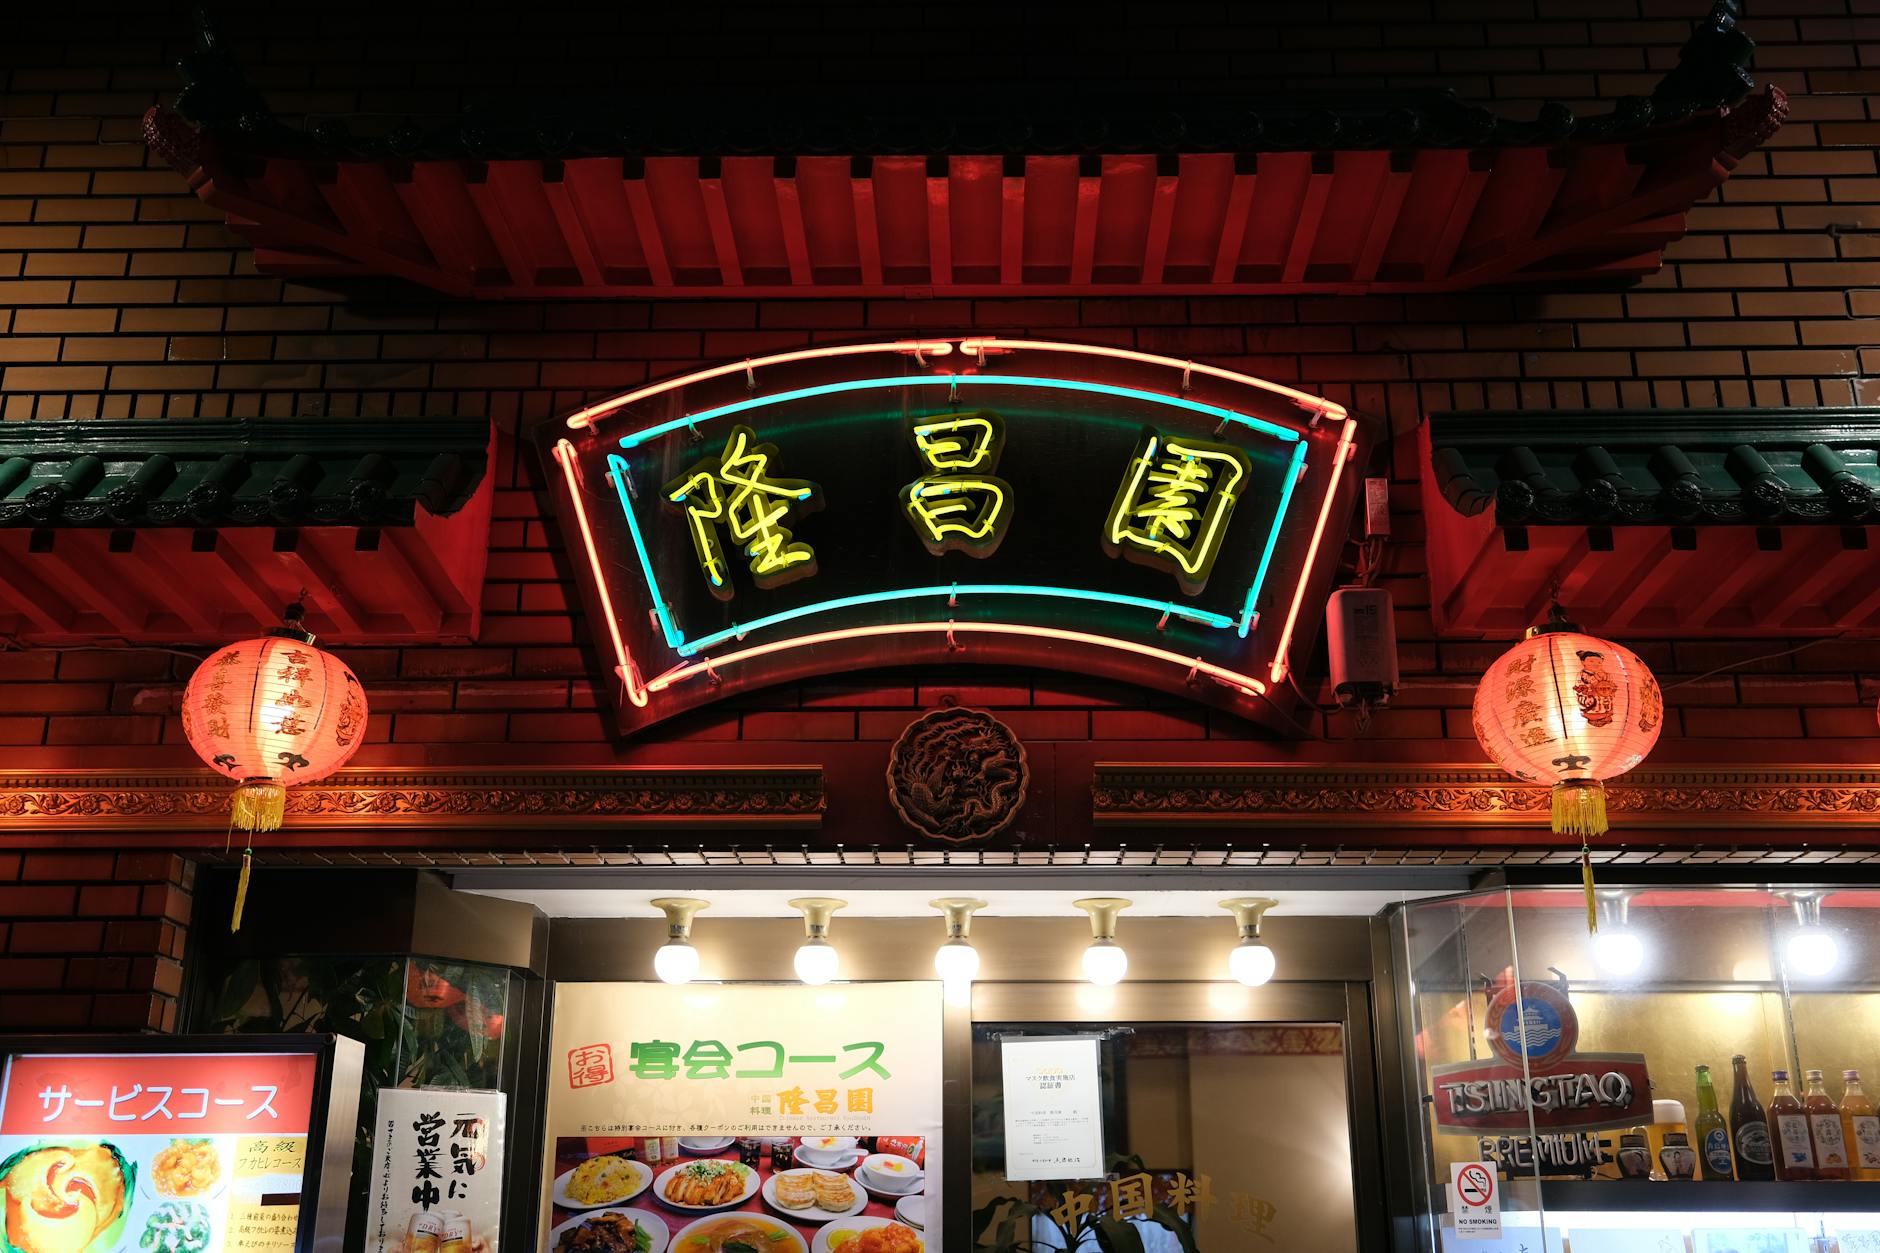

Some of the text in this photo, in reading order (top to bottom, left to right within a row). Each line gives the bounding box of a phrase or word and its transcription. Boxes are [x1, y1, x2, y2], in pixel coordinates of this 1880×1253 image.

[270, 649, 313, 736] 吉祥如意
[574, 1050, 607, 1086] お得
[629, 1039, 892, 1081] 宴会コース
[38, 1084, 279, 1122] サービスコース
[1440, 1071, 1632, 1115] TSINGTAO
[239, 1157, 302, 1170] フカヒレコース
[249, 1140, 297, 1154] 高級
[411, 1111, 446, 1211] 営業中
[449, 1112, 485, 1199] 元気に
[1050, 1171, 1278, 1245] 中国料理
